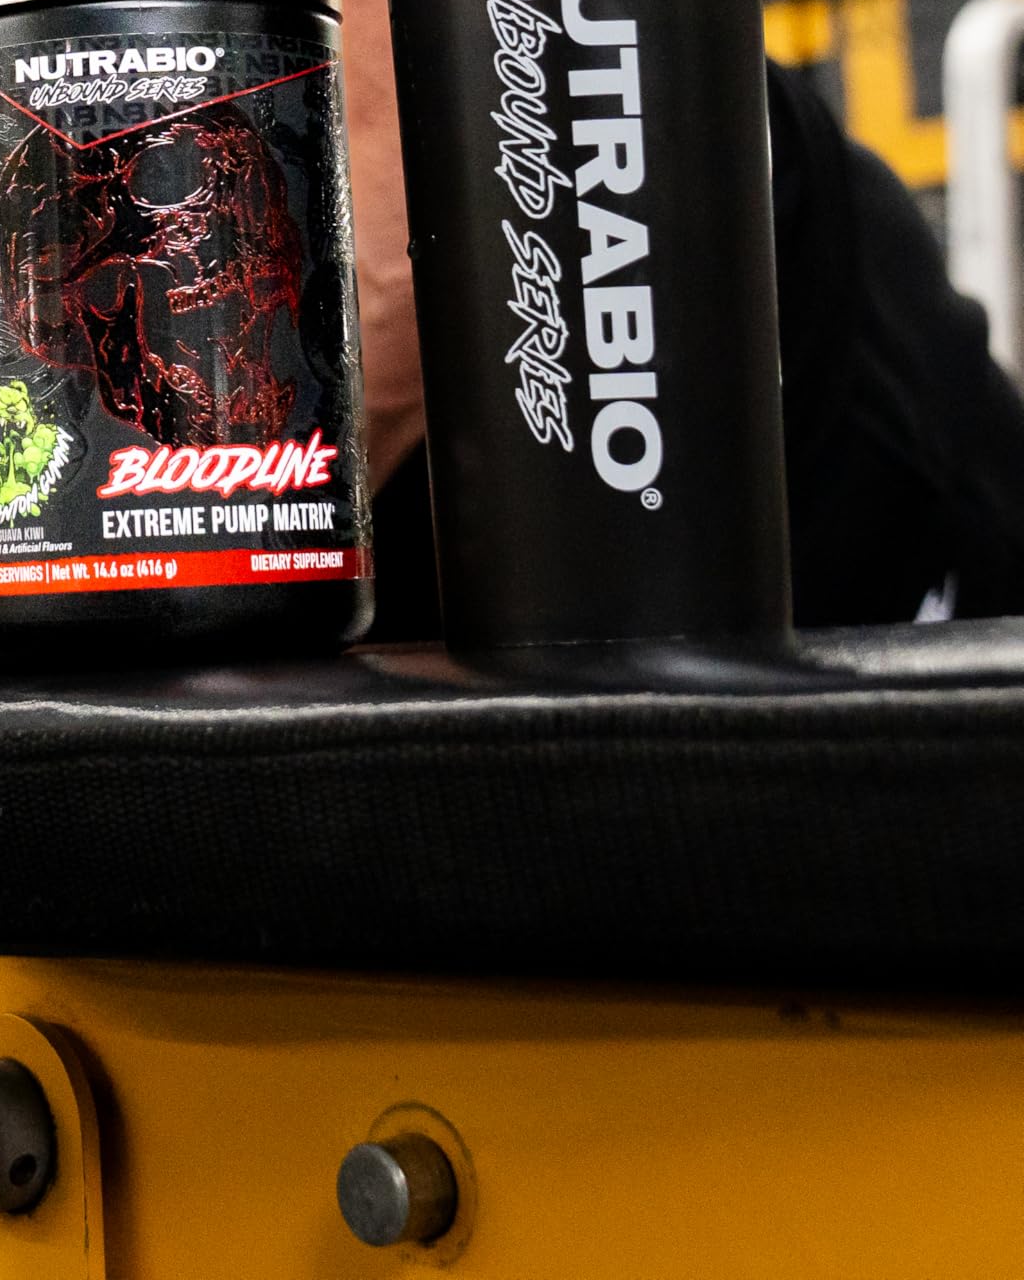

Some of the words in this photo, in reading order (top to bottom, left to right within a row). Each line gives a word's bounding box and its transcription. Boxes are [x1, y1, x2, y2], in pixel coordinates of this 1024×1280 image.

[29, 74, 124, 109] UNBOUND
[128, 76, 208, 102] SERIES
[502, 219, 573, 452] SERIES
[97, 427, 338, 499] BLOODLINE
[24, 527, 45, 540] KIWI
[102, 506, 206, 539] EXTREME
[211, 504, 269, 534] PUMP
[9, 542, 41, 553] Artificial
[42, 541, 73, 551] Flavors
[251, 553, 292, 571] DIETARY
[293, 551, 344, 569] SUPPLEMENT
[51, 564, 71, 581] Net
[72, 562, 91, 579] Wt.
[93, 561, 118, 578] 14.6
[120, 564, 134, 577] oz
[136, 559, 163, 577] (416
[164, 558, 178, 579] g)
